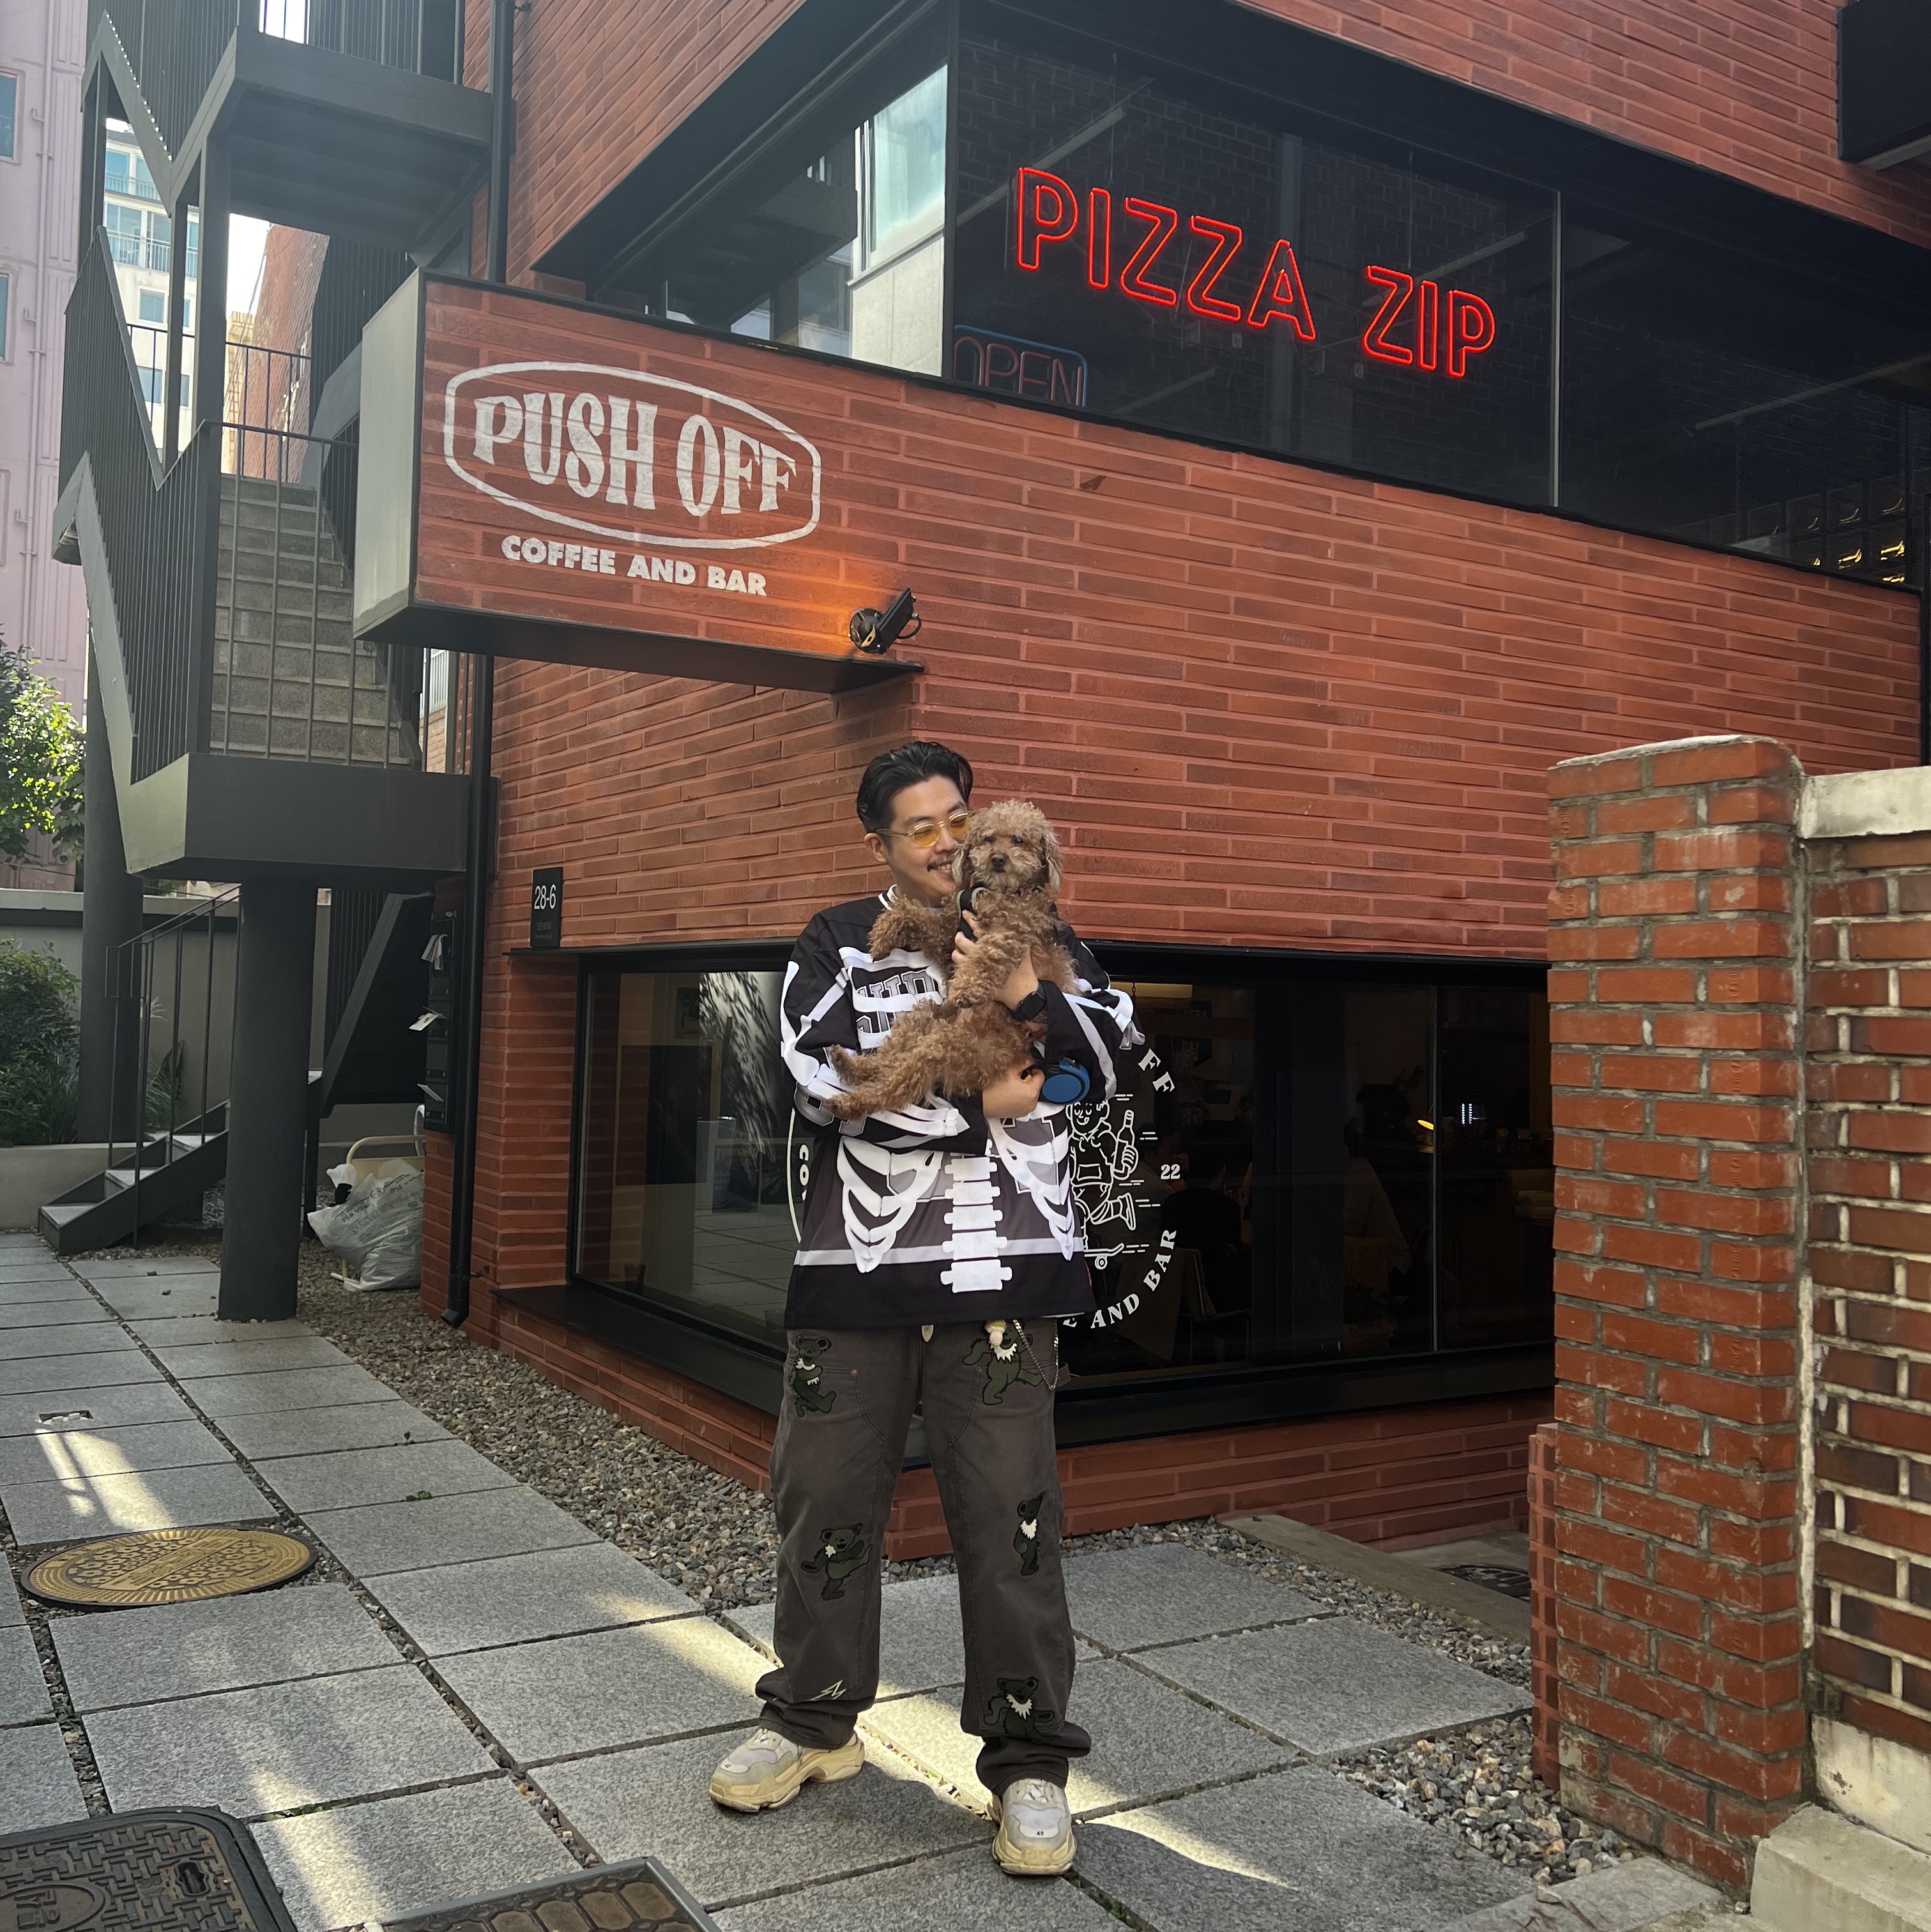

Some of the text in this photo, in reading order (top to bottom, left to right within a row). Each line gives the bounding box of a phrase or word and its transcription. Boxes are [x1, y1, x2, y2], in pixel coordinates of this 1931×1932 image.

[1017, 166, 1496, 379] PIZZA ZIP
[473, 392, 797, 517] PUSH OFF
[501, 535, 768, 597] COFFEE AND BAR
[533, 883, 557, 909] 28-6
[1160, 1164, 1180, 1180] 22
[1090, 1229, 1177, 1329] AND BAR
